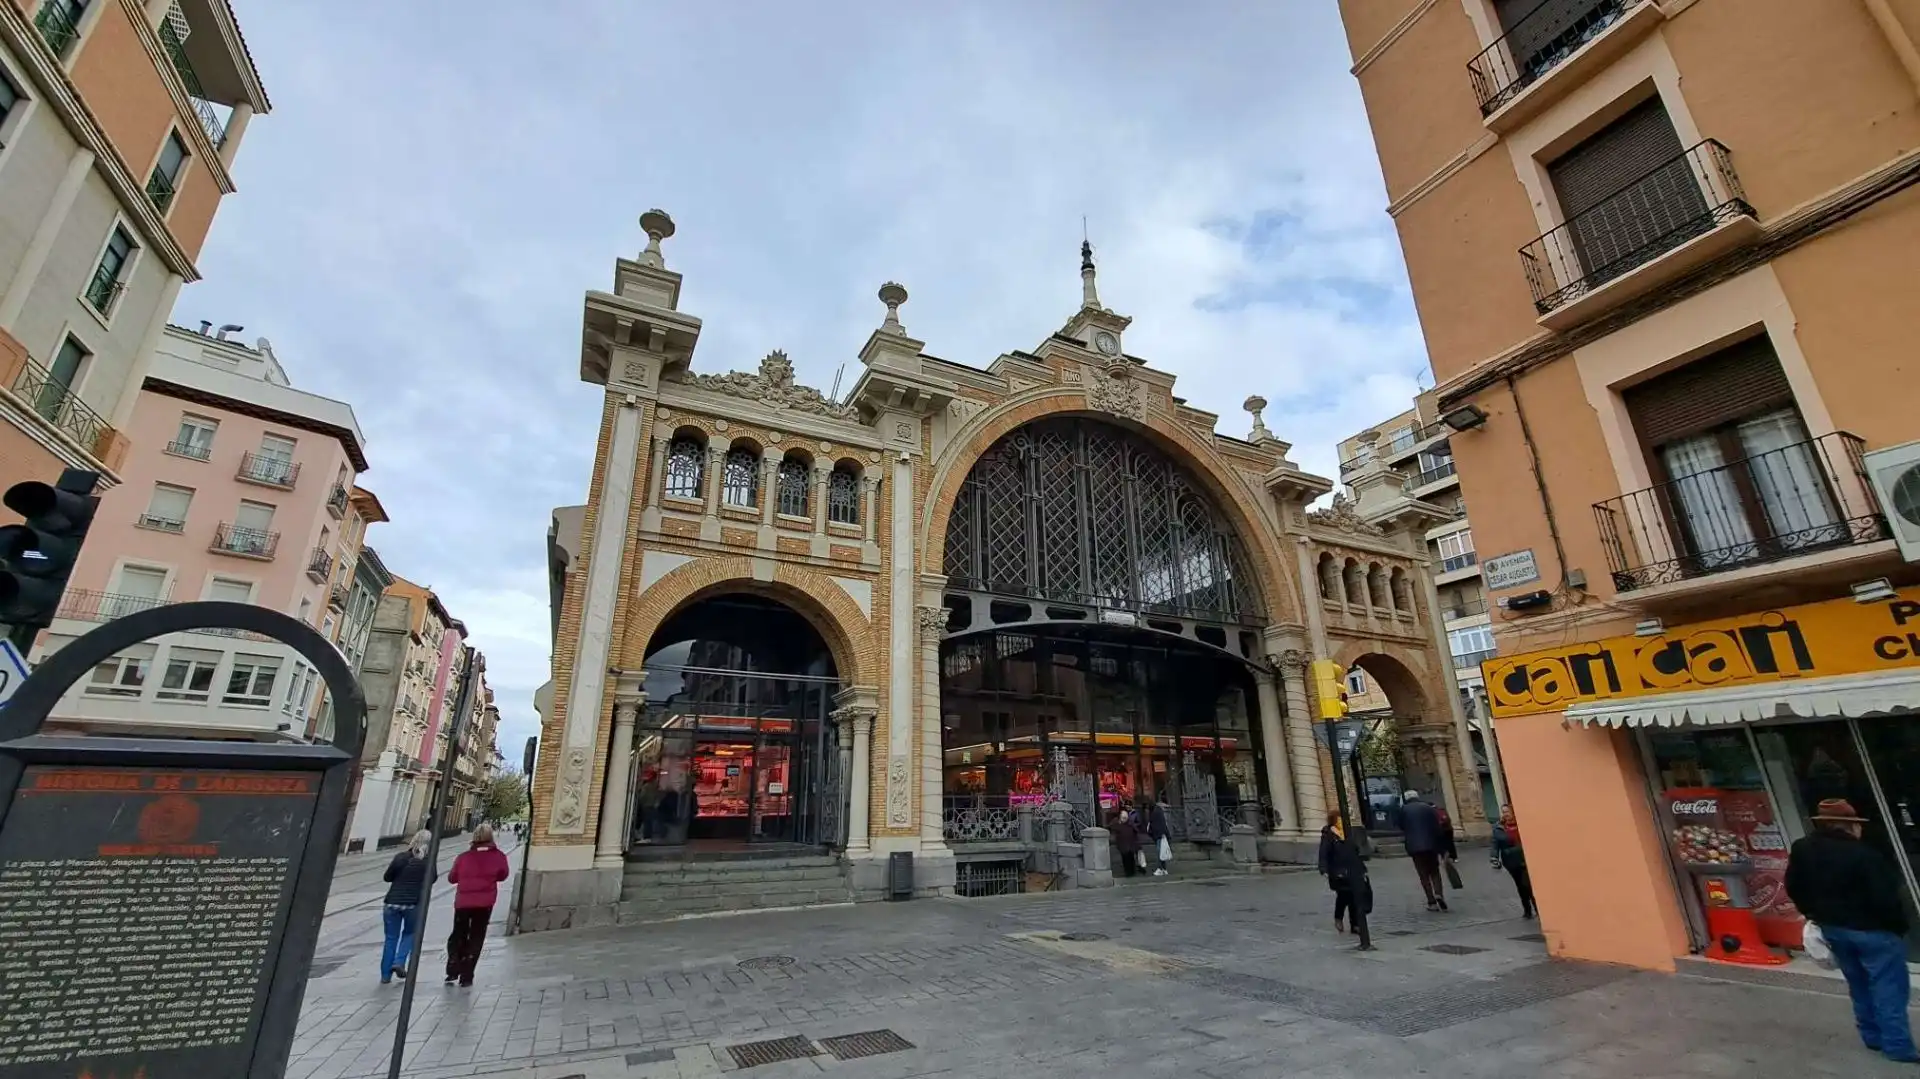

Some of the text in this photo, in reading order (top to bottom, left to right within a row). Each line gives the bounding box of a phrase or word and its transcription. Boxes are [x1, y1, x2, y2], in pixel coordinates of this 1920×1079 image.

[1500, 554, 1531, 568] AVENIDA
[35, 774, 308, 792] HISTORIA DE ZARAGOZA
[1672, 799, 1718, 814] Coca-Cola
